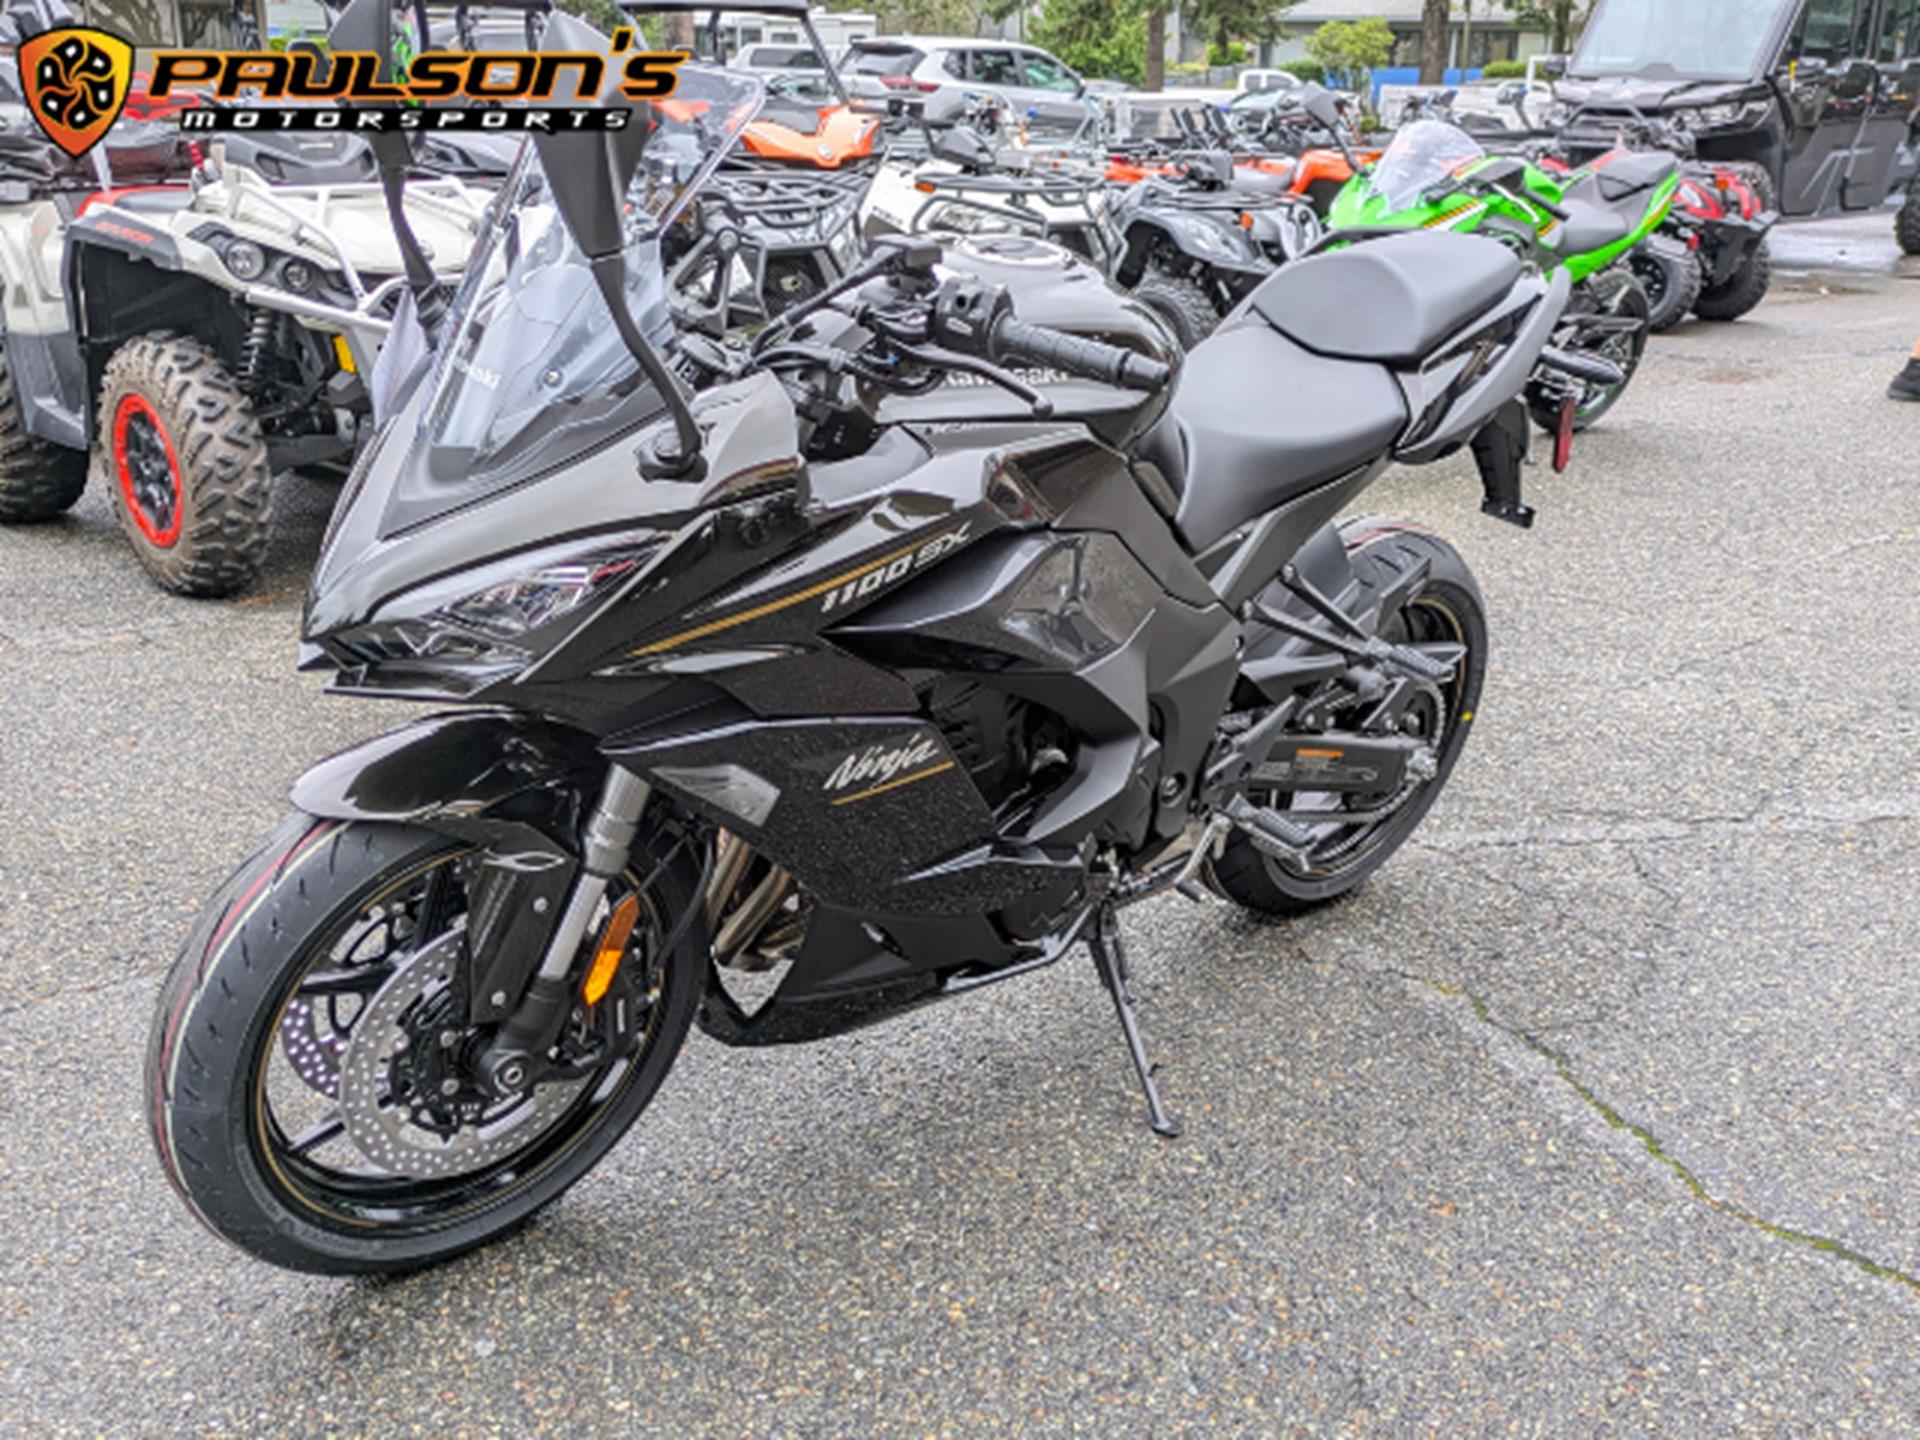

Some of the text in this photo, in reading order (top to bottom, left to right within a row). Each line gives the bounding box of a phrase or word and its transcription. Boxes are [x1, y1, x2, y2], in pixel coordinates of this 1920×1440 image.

[820, 520, 973, 613] 1100 SX
[823, 732, 939, 791] Ninja
